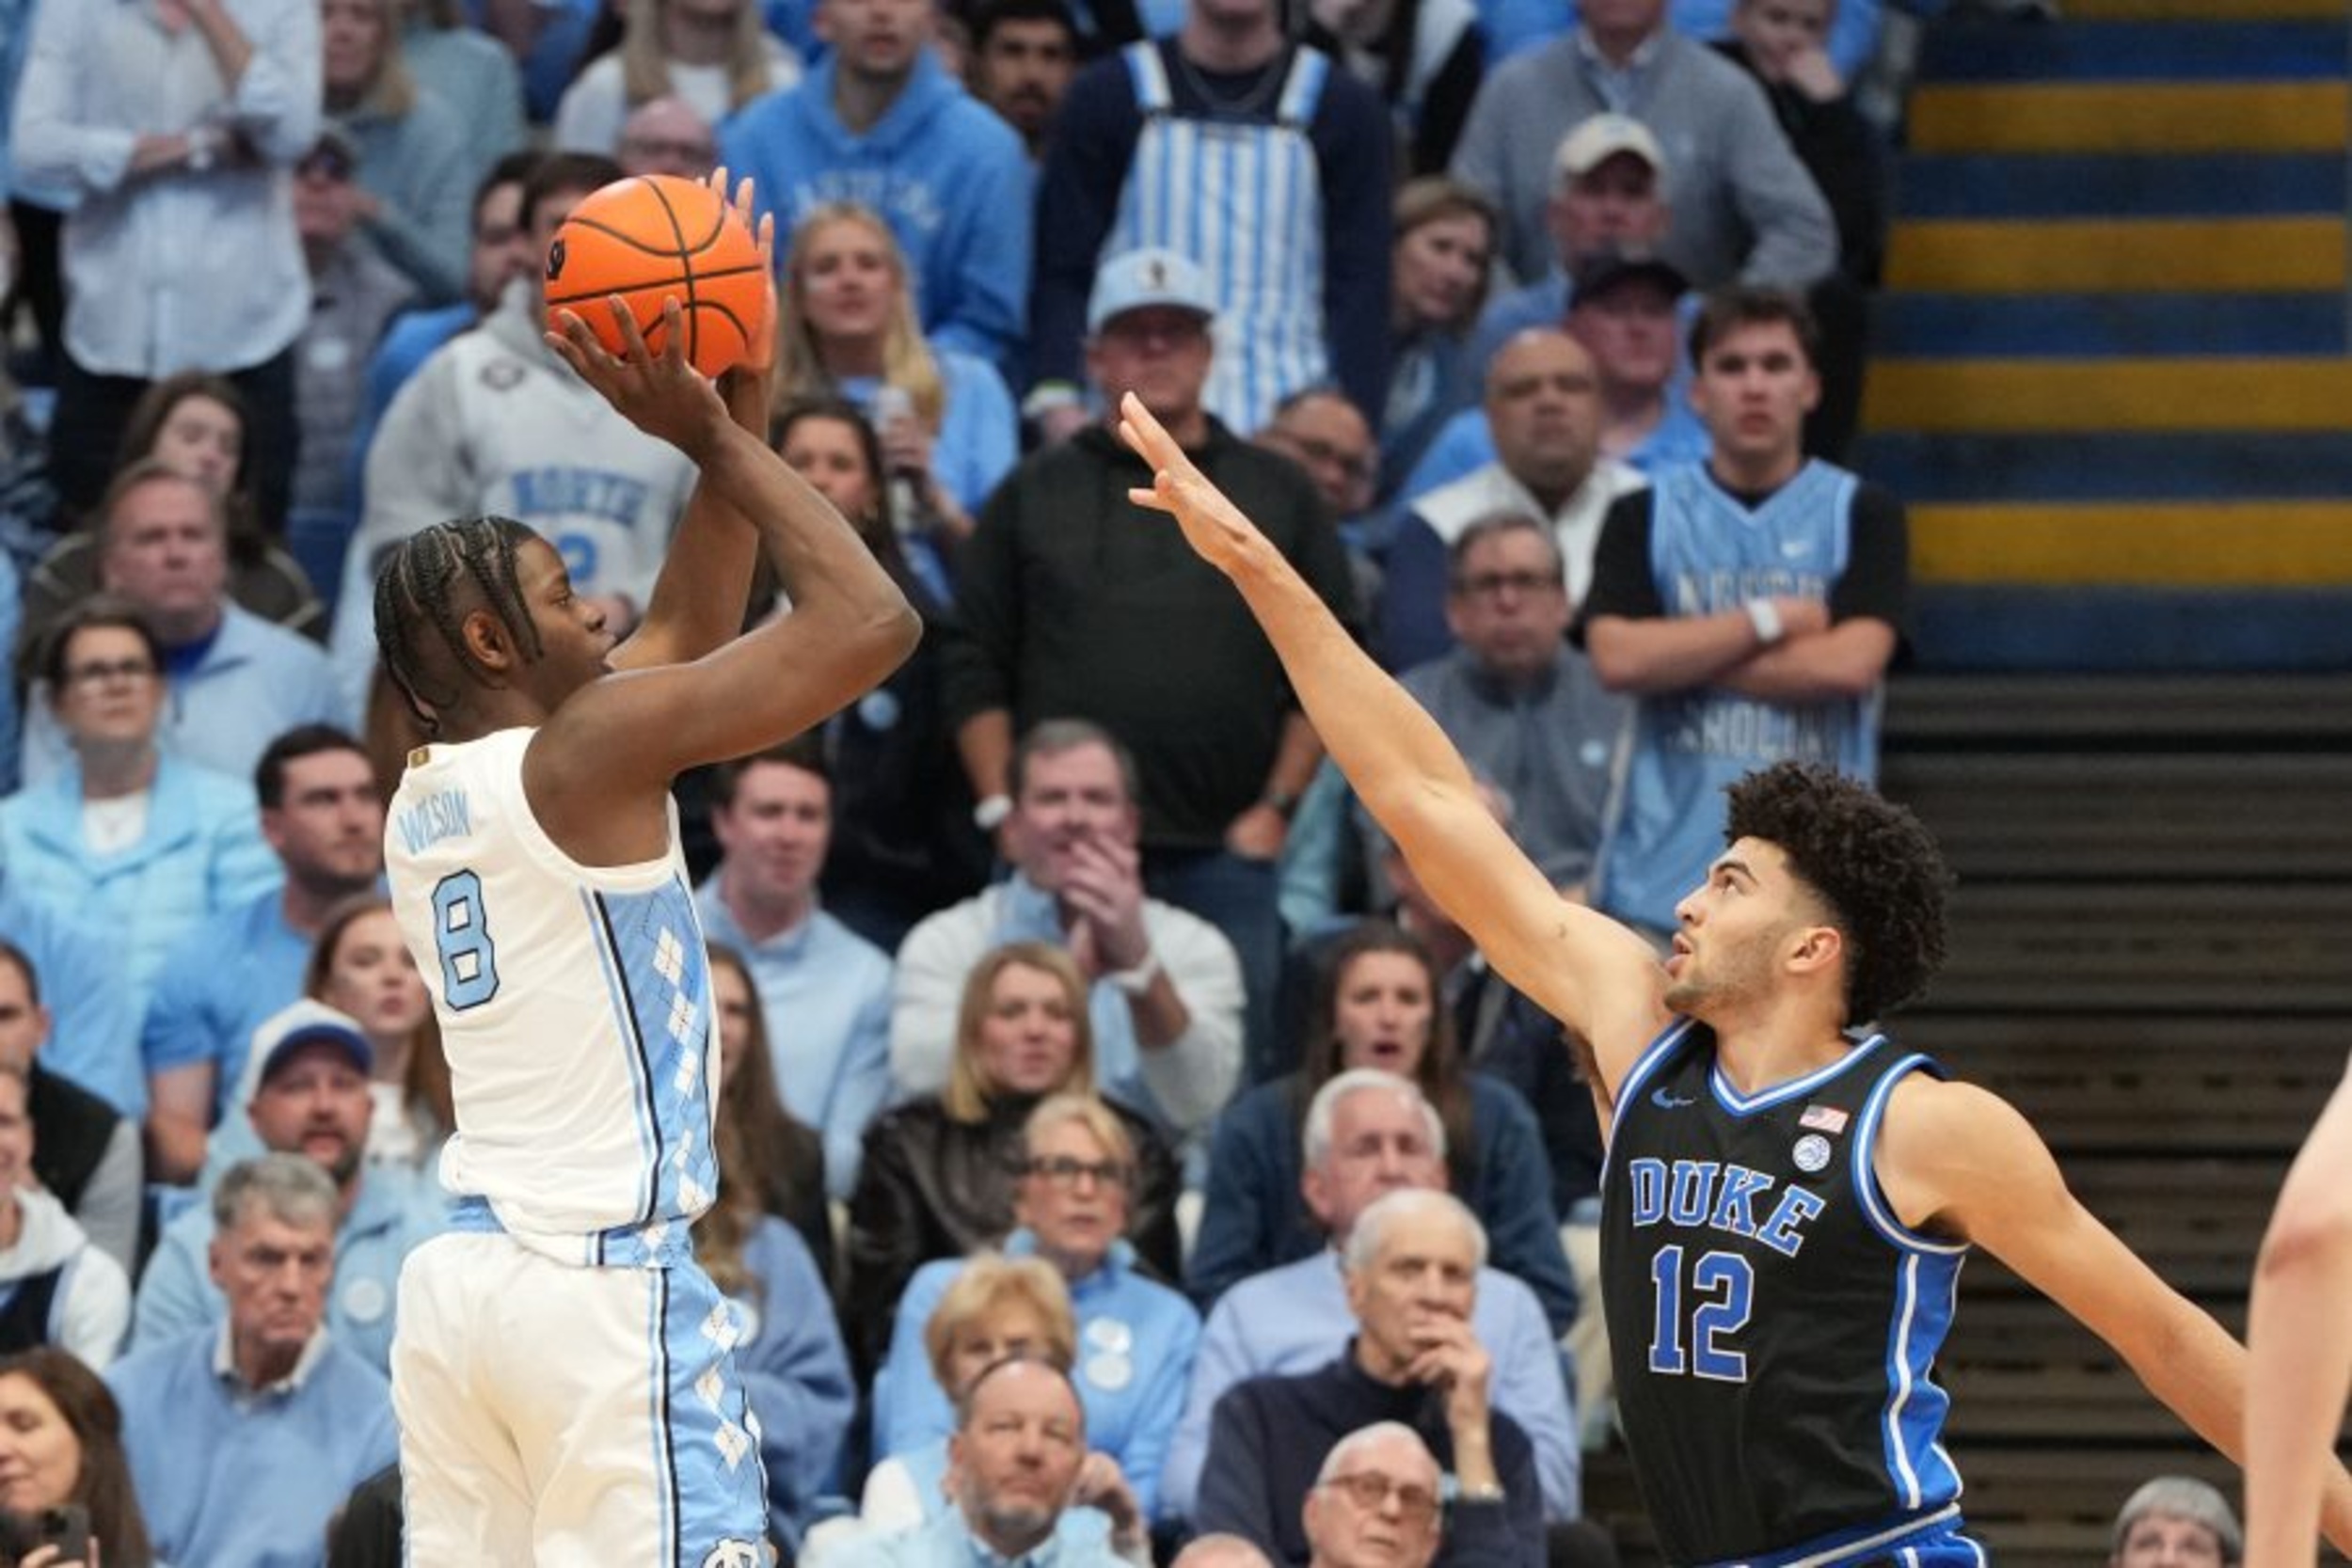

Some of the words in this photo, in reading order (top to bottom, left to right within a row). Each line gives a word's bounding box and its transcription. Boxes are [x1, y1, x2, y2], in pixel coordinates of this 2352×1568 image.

[431, 868, 501, 1012] 8
[1629, 1157, 1826, 1259] DUKE
[1648, 1243, 1755, 1383] 12
